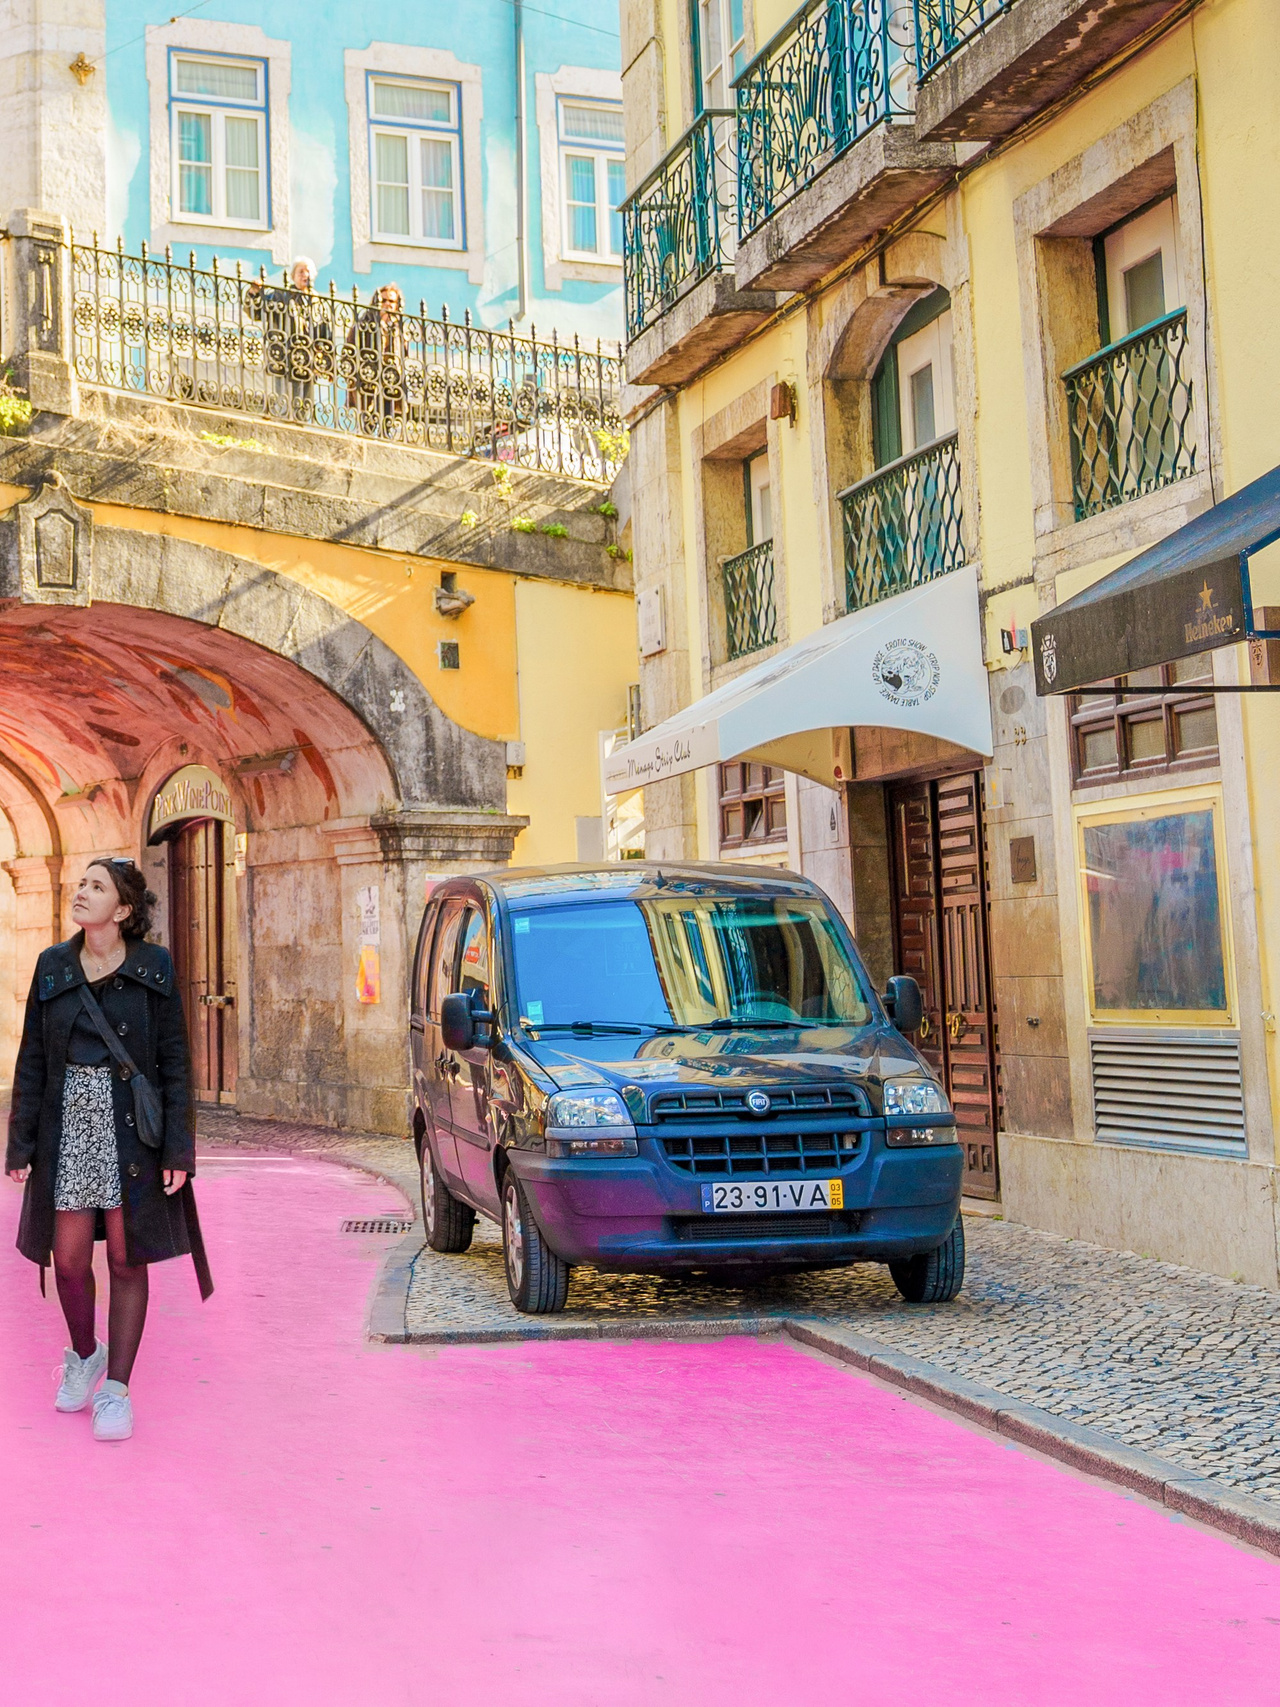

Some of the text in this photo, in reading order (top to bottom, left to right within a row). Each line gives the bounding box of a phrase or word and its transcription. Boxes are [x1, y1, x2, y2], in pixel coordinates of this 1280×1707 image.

[1184, 614, 1233, 643] Heineken
[885, 638, 927, 651] EROTIC SHOW
[872, 650, 885, 685] LAP DANCE
[923, 652, 941, 701] STRIP NON STOP
[879, 687, 920, 707] TABLE DANCE
[655, 747, 673, 773] Strip
[674, 740, 691, 762] Club
[155, 780, 233, 822] PINK WINE POINT
[752, 1098, 766, 1106] FIAT
[830, 1184, 841, 1192] 03
[831, 1197, 842, 1206] 05
